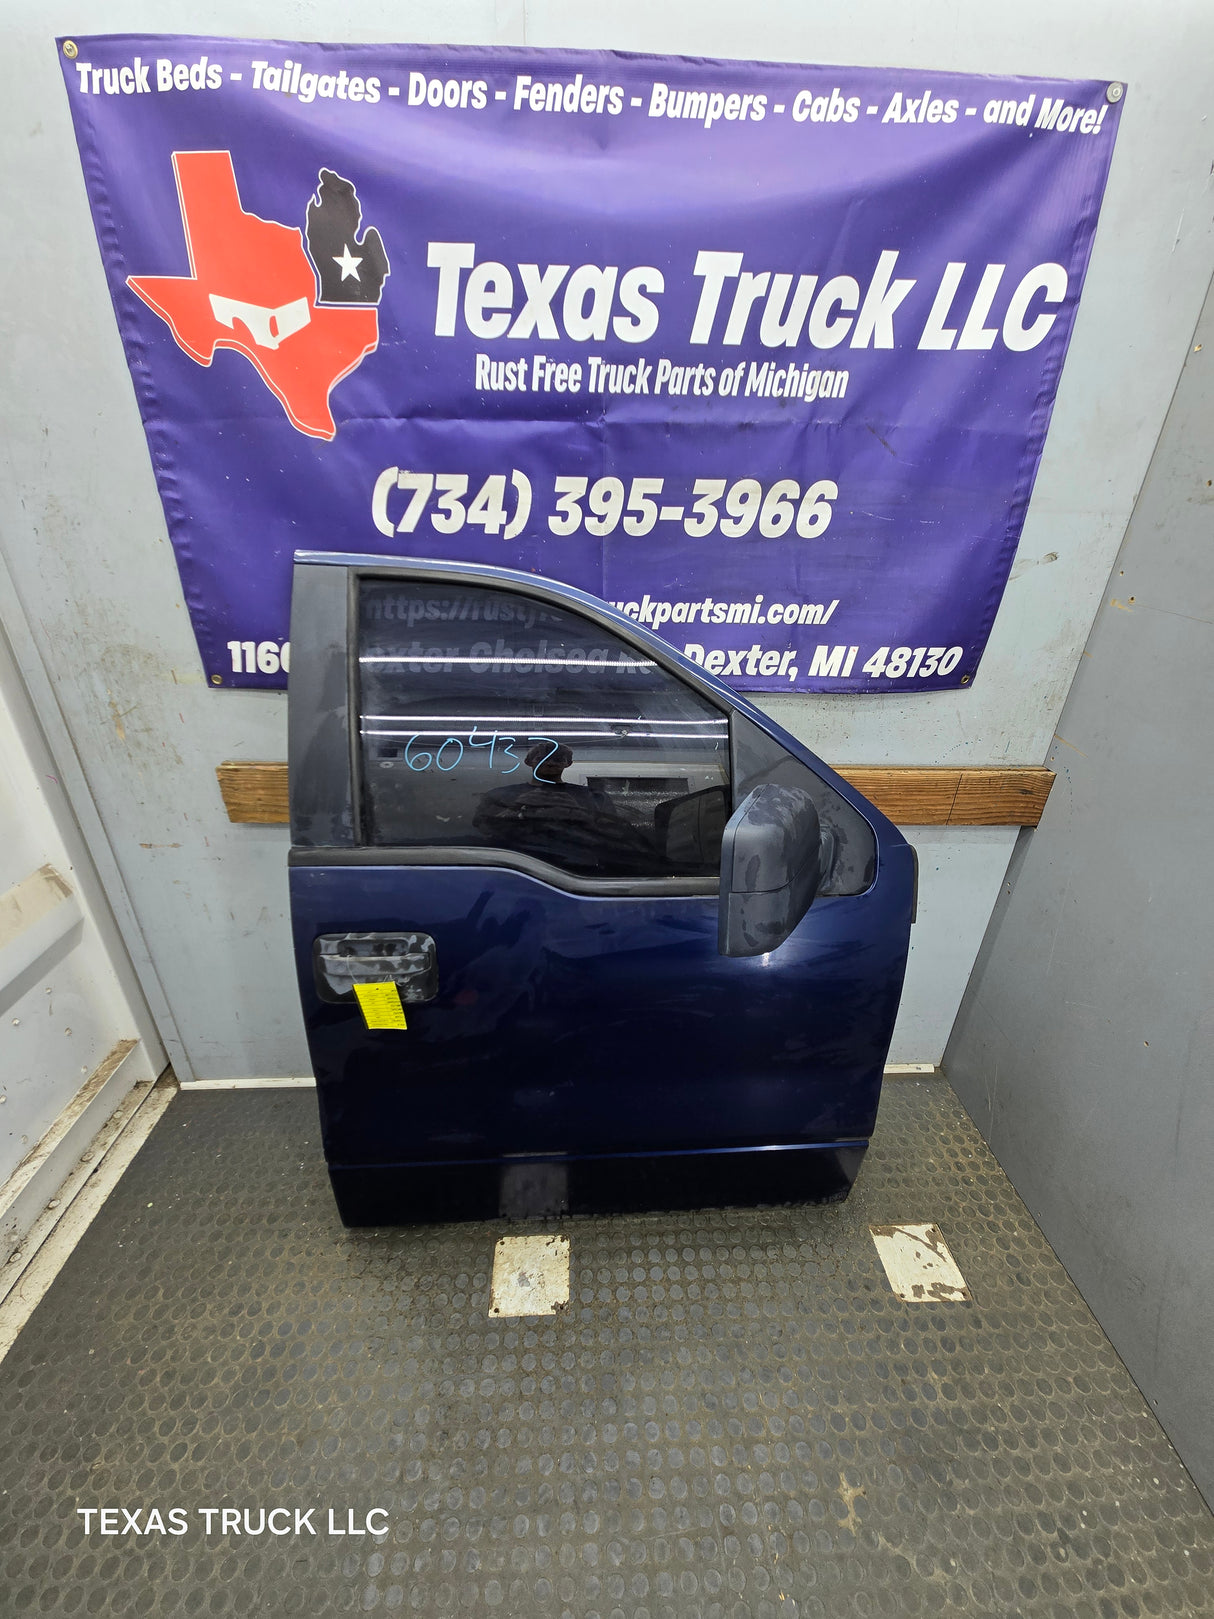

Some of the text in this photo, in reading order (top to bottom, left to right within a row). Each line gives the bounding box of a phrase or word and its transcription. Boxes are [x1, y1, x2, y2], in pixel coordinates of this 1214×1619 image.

[76, 57, 151, 95] Truck
[157, 57, 223, 92] Beds
[251, 59, 381, 104] Tailgates
[408, 72, 487, 110] Doors
[514, 74, 624, 116] Fenders
[648, 83, 767, 128] Bumpers
[792, 88, 861, 123] Cabs
[881, 90, 958, 124] Axles
[983, 94, 1036, 126] and
[1034, 97, 1108, 135] More!
[427, 242, 1068, 352] Texas Truck LLC
[475, 354, 850, 402] Rust Free Truck Parts of Michigan
[372, 466, 838, 540] (734) 395-3966
[366, 641, 460, 674] exter
[469, 639, 608, 675] Chelsea
[683, 644, 798, 682] Dexter,
[808, 646, 859, 677] MI
[862, 646, 964, 678] 48130
[404, 726, 560, 784] 60432
